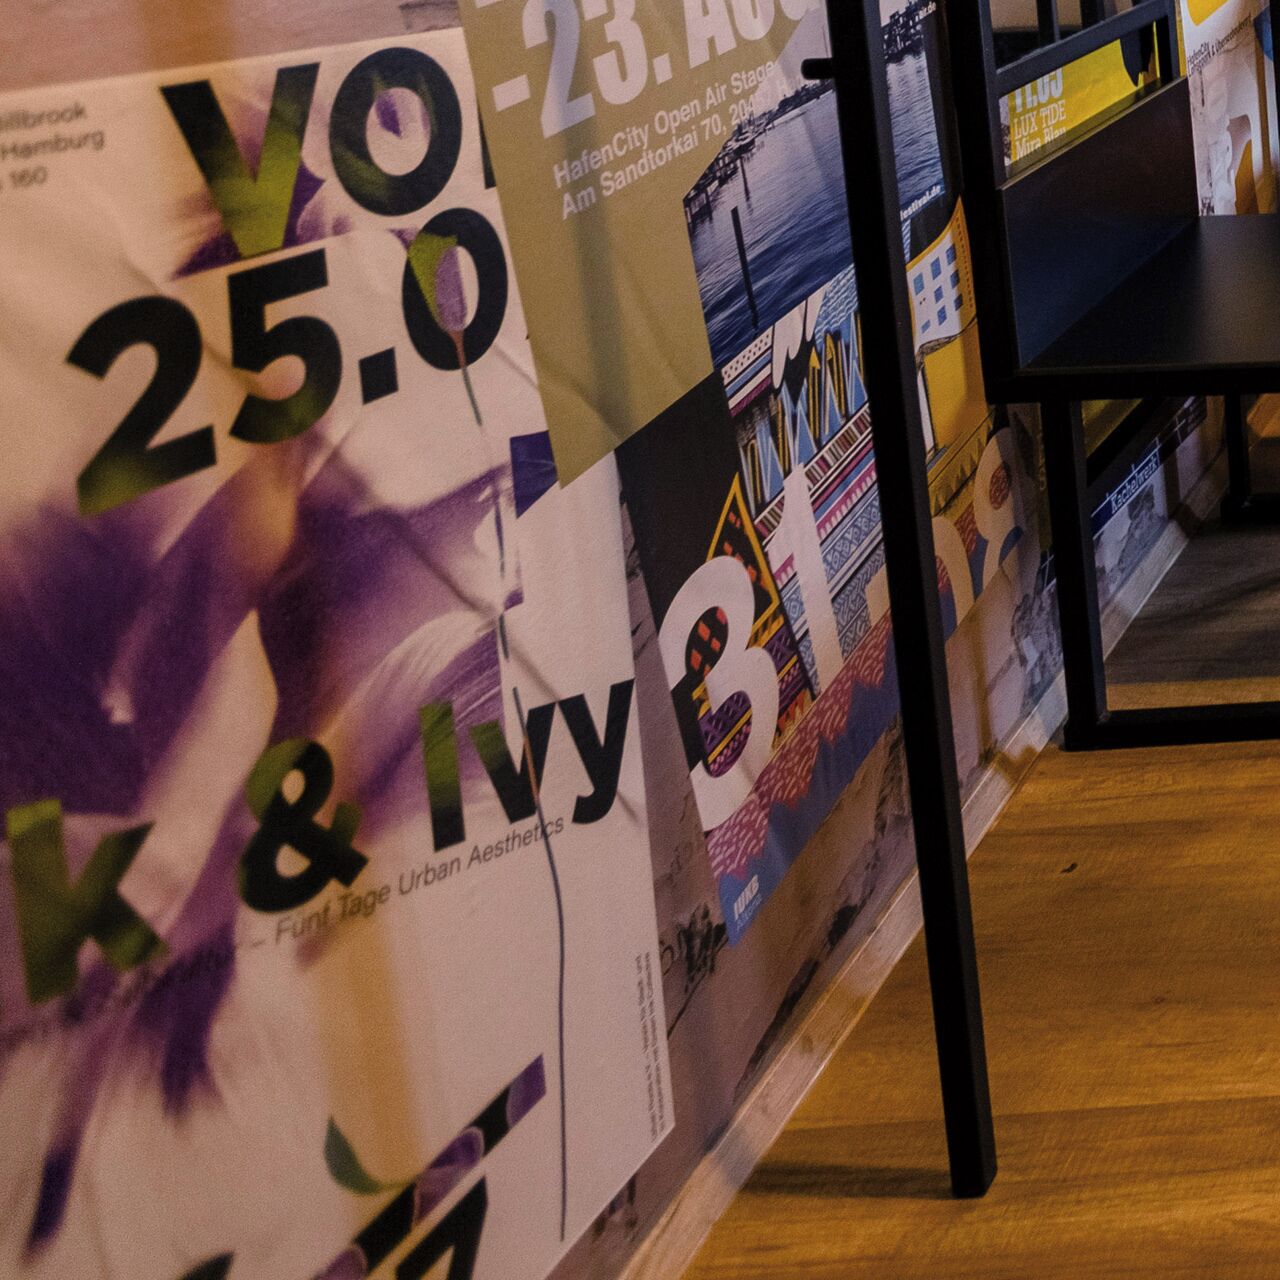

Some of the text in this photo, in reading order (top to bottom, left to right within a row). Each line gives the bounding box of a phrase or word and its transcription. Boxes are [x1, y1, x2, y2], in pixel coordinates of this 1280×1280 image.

[160, 46, 497, 259] VO
[553, 123, 650, 190] HafenCity
[655, 98, 701, 137] Open
[705, 81, 728, 112] Air
[562, 184, 597, 220] Am
[600, 131, 699, 198] Sandtorkai
[700, 113, 728, 144] 70,
[1041, 99, 1067, 128] TIDE
[238, 737, 369, 915] &
[417, 677, 636, 854] Ivy
[337, 884, 391, 924] Tage
[398, 856, 461, 896] Urban
[466, 816, 565, 870] Aesthetics
